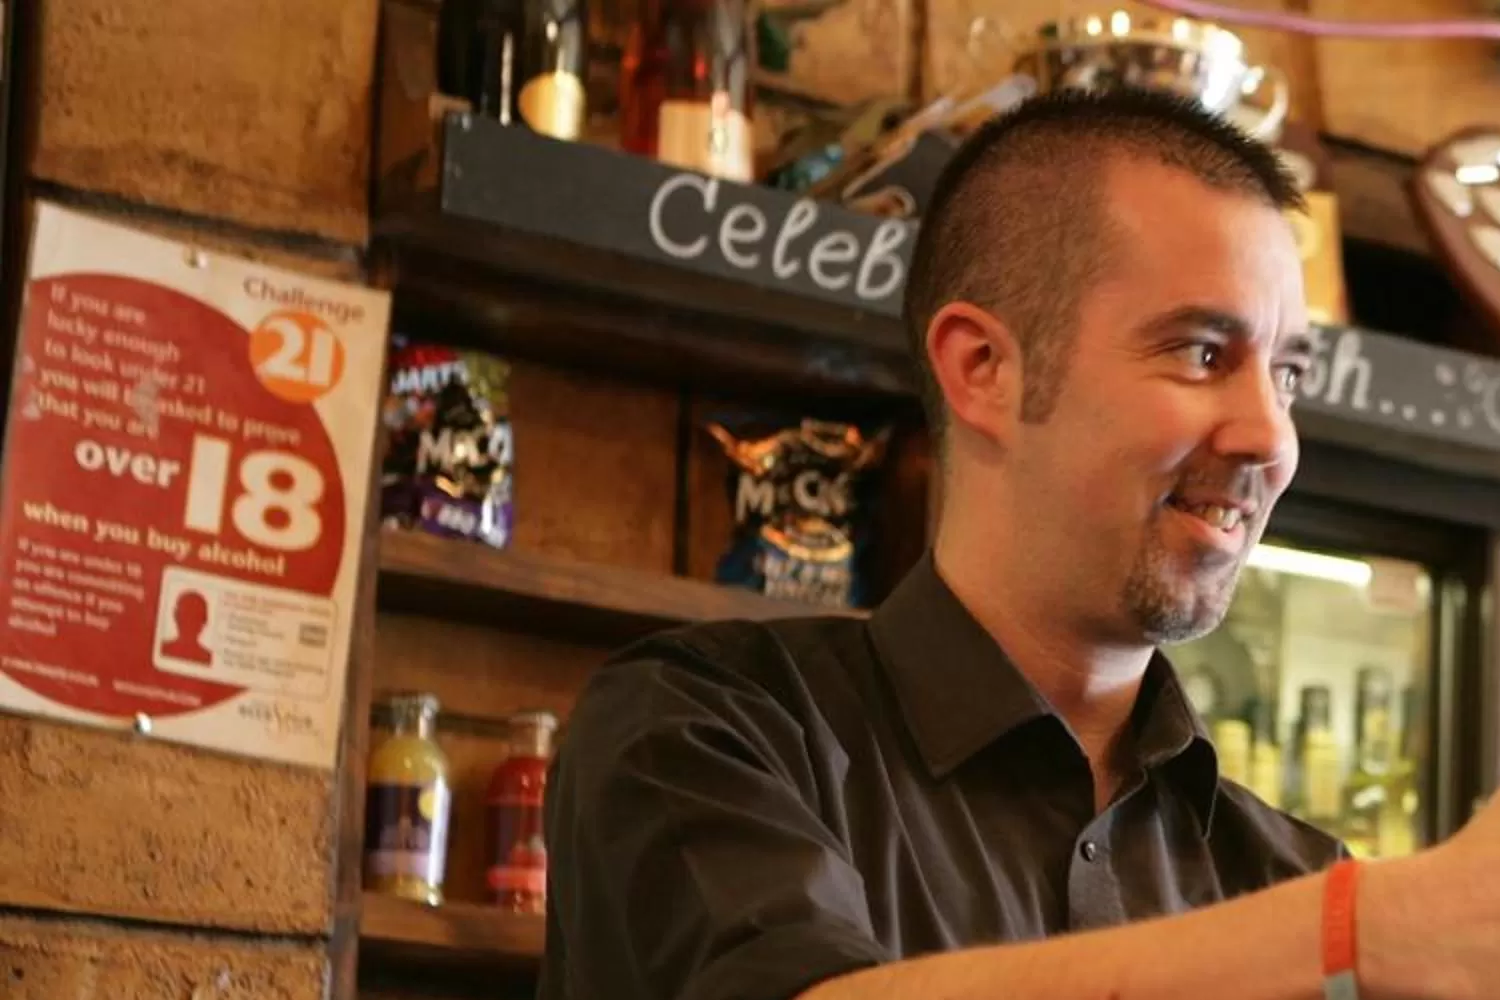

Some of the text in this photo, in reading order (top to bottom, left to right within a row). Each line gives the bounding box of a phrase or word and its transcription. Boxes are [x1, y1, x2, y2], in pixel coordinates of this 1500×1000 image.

[51, 283, 146, 325] If you are
[243, 276, 367, 327] Challenge
[44, 338, 67, 360] to
[70, 344, 114, 374] look
[181, 374, 206, 396] 21
[47, 308, 180, 367] lucky enough
[259, 316, 336, 387] 21
[38, 394, 79, 421] that
[82, 408, 121, 436] you
[40, 369, 78, 396] you
[82, 380, 119, 403] will
[216, 409, 240, 433] to
[242, 418, 301, 448] prove
[74, 440, 182, 490] over
[184, 433, 325, 551] 18
[24, 500, 286, 577] when you buy alcohol
